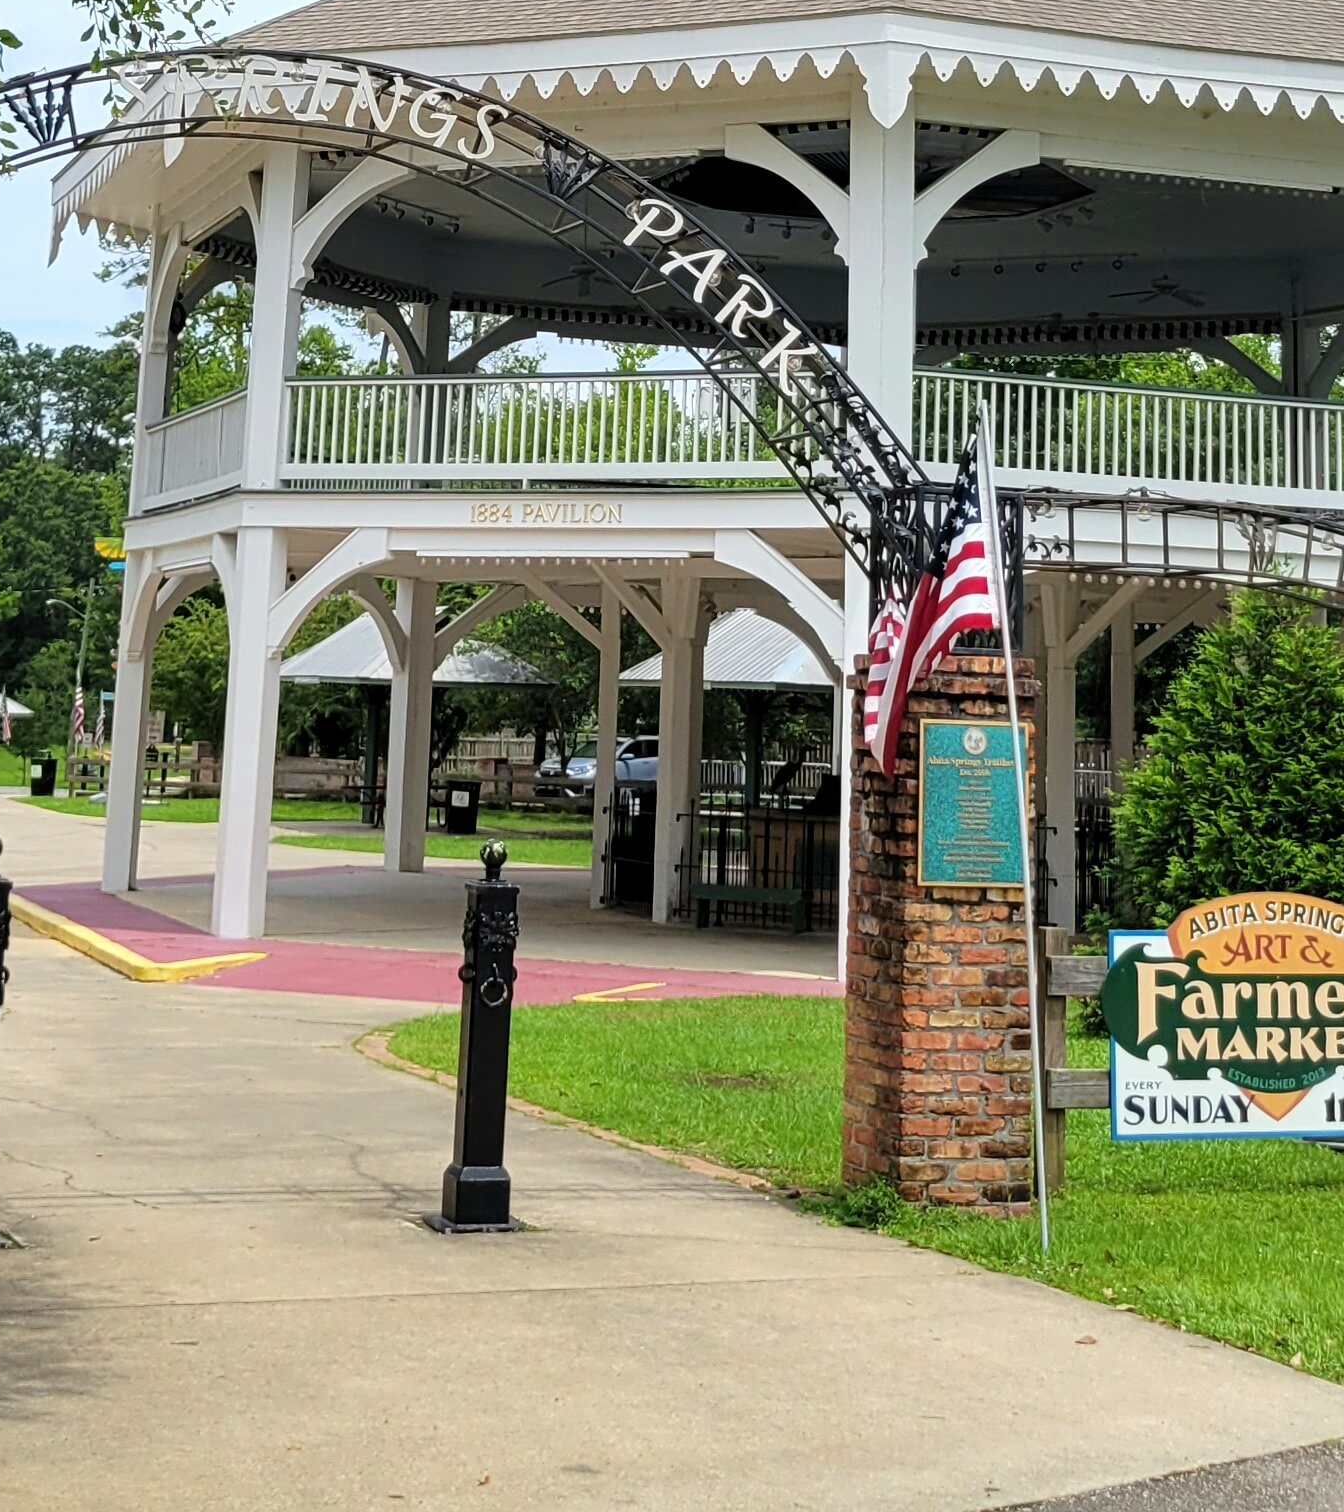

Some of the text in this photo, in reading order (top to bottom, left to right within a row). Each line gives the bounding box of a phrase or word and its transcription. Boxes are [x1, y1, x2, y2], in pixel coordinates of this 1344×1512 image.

[119, 54, 508, 159] SPRINGS
[623, 198, 818, 397] PARK
[470, 503, 624, 524] 1884 PAVILION
[1188, 902, 1259, 942] ABITA
[1219, 929, 1335, 968] ART &
[1125, 1081, 1163, 1091] EVERY
[1227, 1067, 1326, 1090] ESTABLISHED 2013
[1123, 1094, 1255, 1126] SUNDAY
